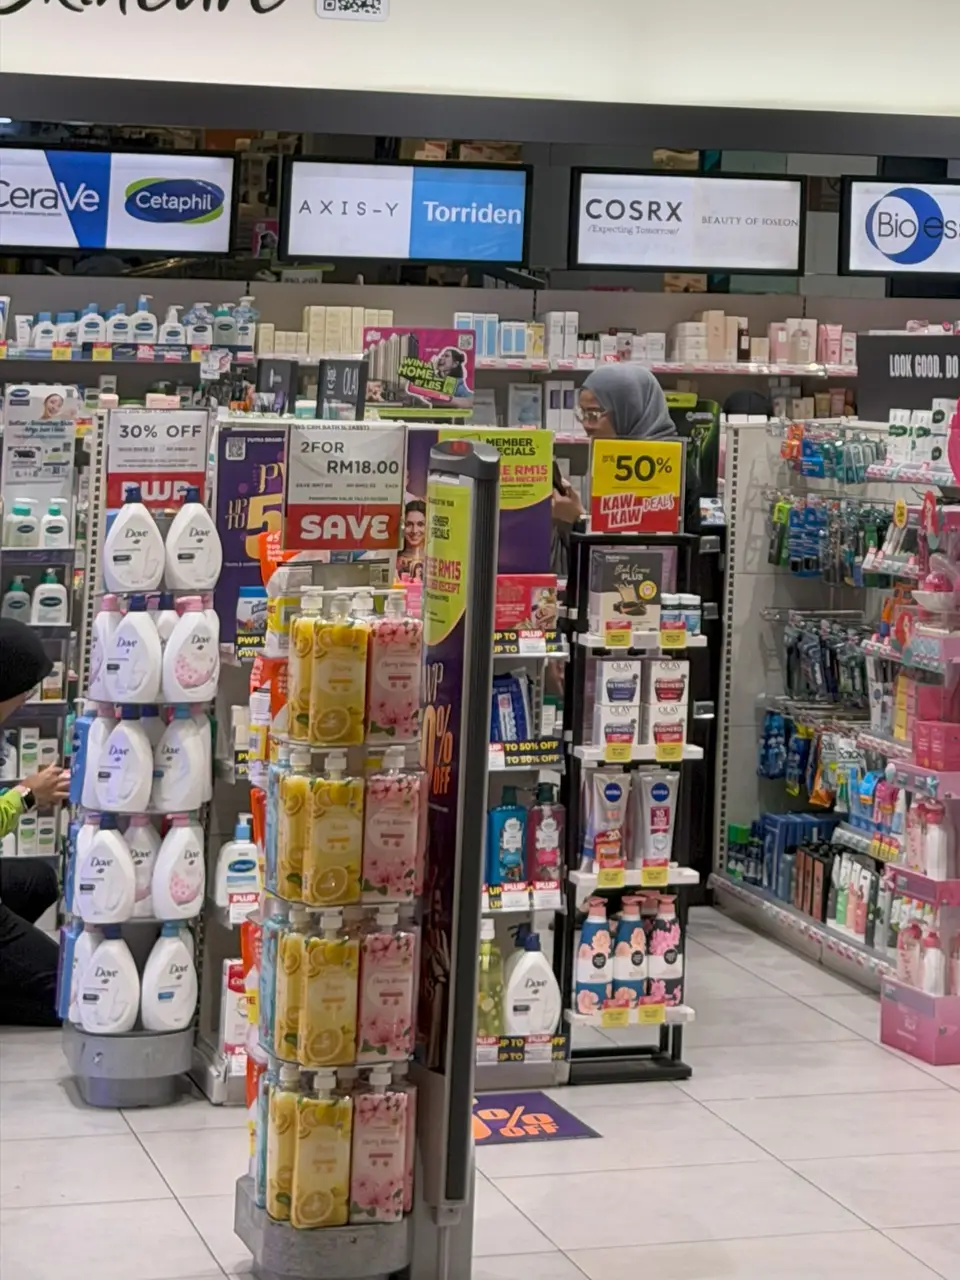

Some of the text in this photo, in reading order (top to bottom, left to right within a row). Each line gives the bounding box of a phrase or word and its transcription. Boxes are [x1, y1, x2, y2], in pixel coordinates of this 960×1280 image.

[136, 191, 212, 212] Cetaphil
[298, 199, 400, 218] AXIS-Y
[423, 201, 522, 225] Torriden
[585, 198, 683, 222] COSRX
[702, 216, 799, 227] BEAUTY OF JOSEON
[878, 212, 917, 238] Bio
[401, 356, 423, 368] WIN
[889, 354, 911, 378] LOOK
[914, 355, 943, 379] GOOD.
[946, 355, 959, 380] DO
[398, 366, 435, 380] HOME
[423, 380, 441, 391] LBS
[119, 424, 202, 438] 30% OFF
[300, 441, 344, 453] 2FOR
[486, 438, 533, 447] MEMBER
[496, 447, 536, 456] ECIALS
[327, 460, 399, 475] RM18.00
[515, 464, 548, 475] RM15
[614, 455, 673, 482] 50%
[602, 493, 674, 512] KAW DEALS
[610, 509, 640, 526] KAW
[300, 514, 390, 540] SAVE
[125, 528, 148, 538] Dove
[189, 528, 211, 538] Dove
[439, 560, 461, 581] RM15
[621, 573, 644, 581] PLUS
[191, 634, 211, 645] Dove
[237, 636, 260, 645] PWP
[504, 633, 517, 641] TO
[545, 632, 557, 640] FF
[117, 637, 138, 648] Dove
[505, 645, 517, 653] TO
[109, 744, 130, 756] Dove
[161, 744, 180, 755] Dove
[505, 741, 559, 751] TO 50% OFF
[506, 755, 519, 764] TO
[541, 754, 560, 762] OFF
[132, 849, 152, 860] Dove
[184, 849, 200, 859] Dove
[91, 856, 114, 868] Dove
[95, 967, 118, 977] Dove
[169, 964, 189, 975] Dove
[525, 978, 547, 988] Dove
[511, 1038, 524, 1047] TO
[552, 1037, 566, 1045] FF
[511, 1052, 524, 1061] TO
[499, 1122, 560, 1137] OFF
